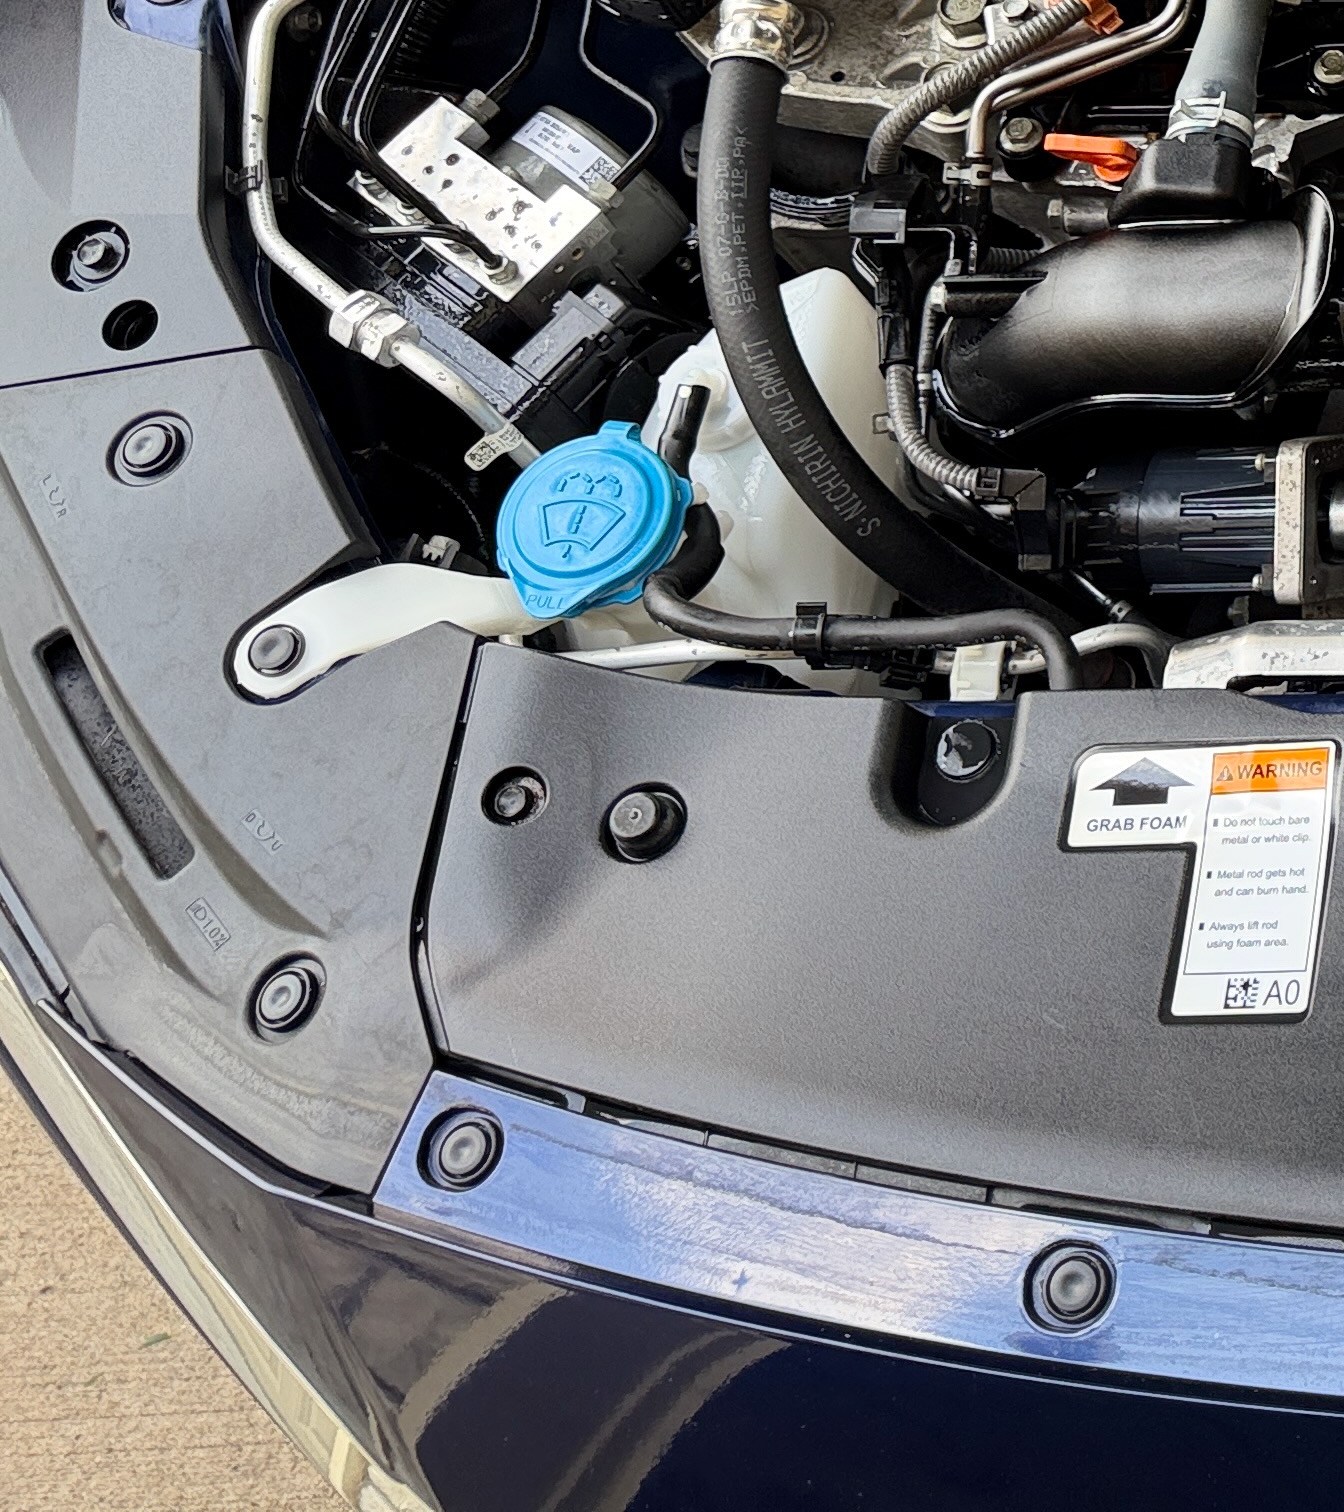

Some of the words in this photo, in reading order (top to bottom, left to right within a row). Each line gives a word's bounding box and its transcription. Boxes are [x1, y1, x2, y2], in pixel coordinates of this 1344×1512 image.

[741, 337, 807, 436] HYLAMMIT
[525, 593, 566, 611] PULL
[1238, 761, 1322, 779] WARNING
[1087, 818, 1134, 832] GRAB
[1140, 815, 1187, 830] FOAM
[1223, 818, 1238, 827] Do
[1240, 817, 1256, 826] not
[1259, 816, 1285, 825] touch
[1288, 816, 1310, 824] bare
[1222, 835, 1249, 845] metal
[1264, 834, 1289, 843] white
[1292, 833, 1311, 843] clip.
[1217, 870, 1244, 879] Metal
[1247, 869, 1262, 878] rod
[1265, 869, 1286, 880] gets
[1289, 868, 1305, 876] hot
[1214, 887, 1233, 897] and
[1236, 888, 1254, 896] can
[1257, 886, 1279, 895] burn
[1209, 922, 1244, 933] Always
[1248, 921, 1259, 929] lift
[1262, 920, 1278, 929] rod
[1207, 940, 1233, 950] using
[1237, 939, 1261, 948] foam
[1262, 980, 1300, 1006] A0
